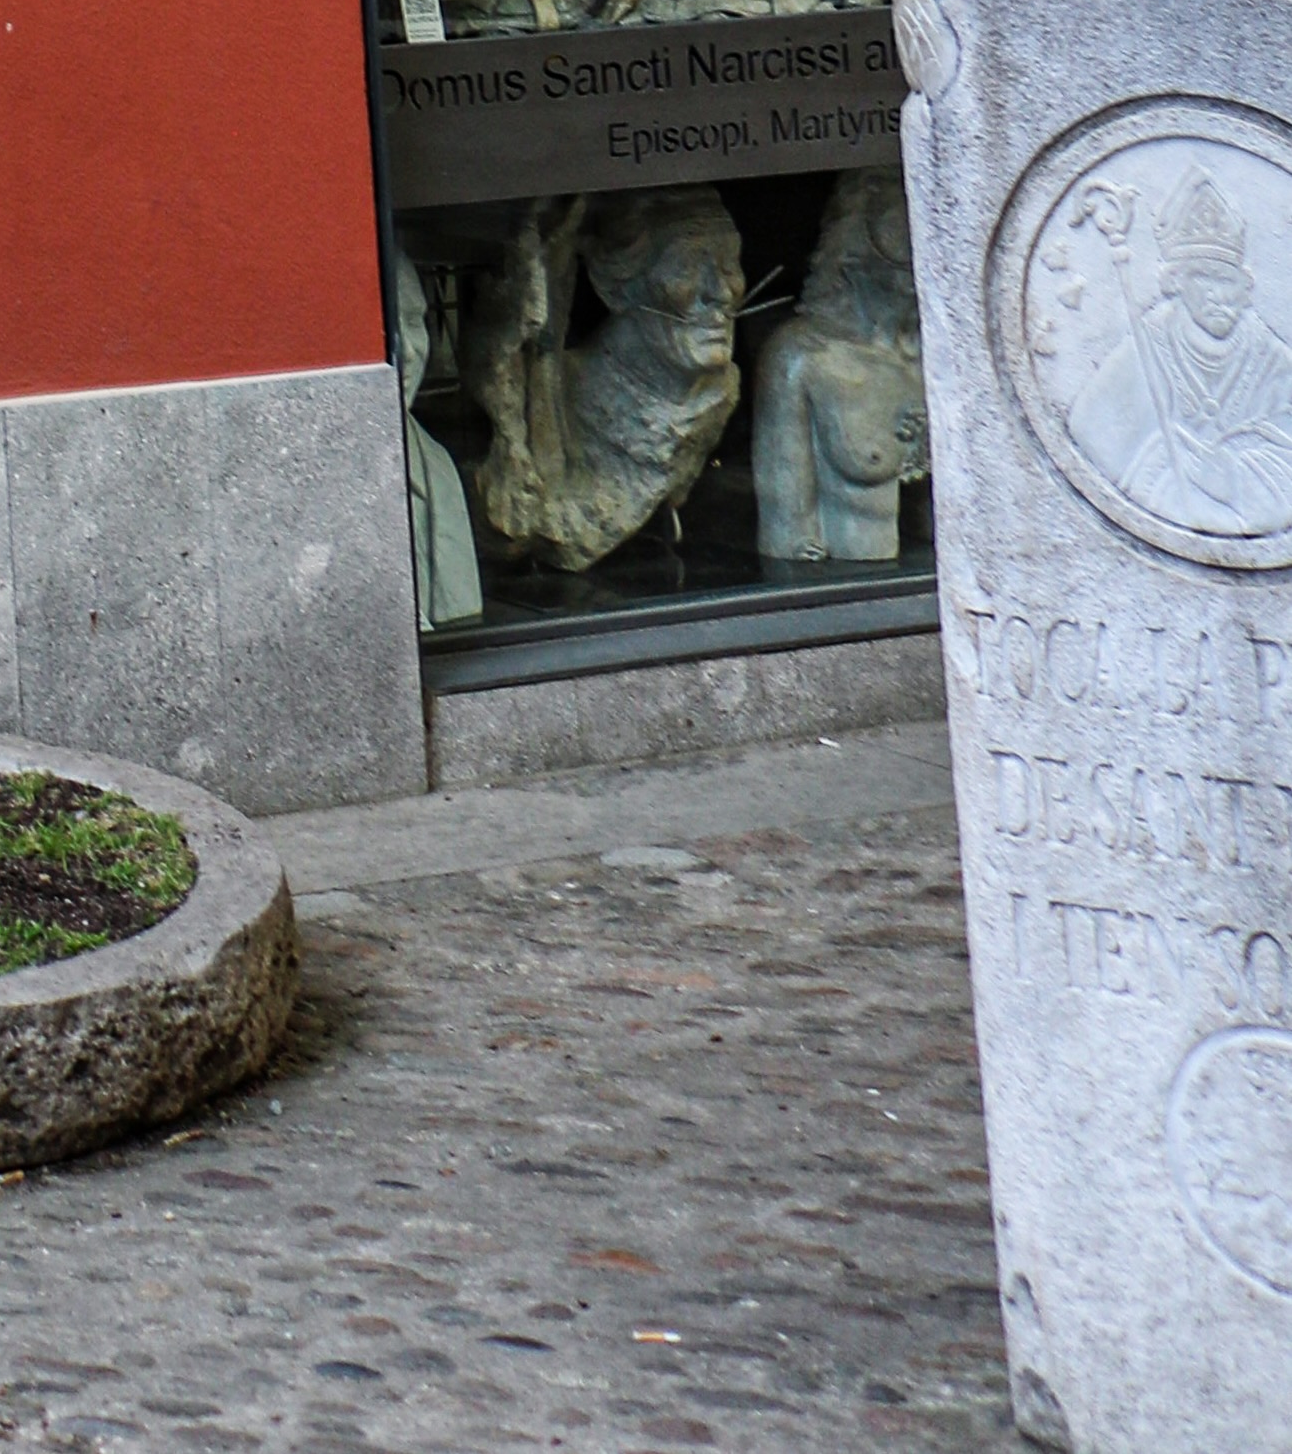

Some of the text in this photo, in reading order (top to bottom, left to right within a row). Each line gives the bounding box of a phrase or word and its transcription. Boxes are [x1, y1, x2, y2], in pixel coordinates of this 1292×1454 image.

[382, 66, 527, 111] Domus
[541, 46, 672, 99] Sancti
[687, 32, 851, 86] Narcissi
[770, 101, 902, 146] Martyris
[965, 608, 1129, 712] TOCA
[1143, 623, 1239, 725] LA
[988, 749, 1075, 845] DE
[1090, 761, 1257, 872] SANT
[1206, 923, 1292, 1019] SO
